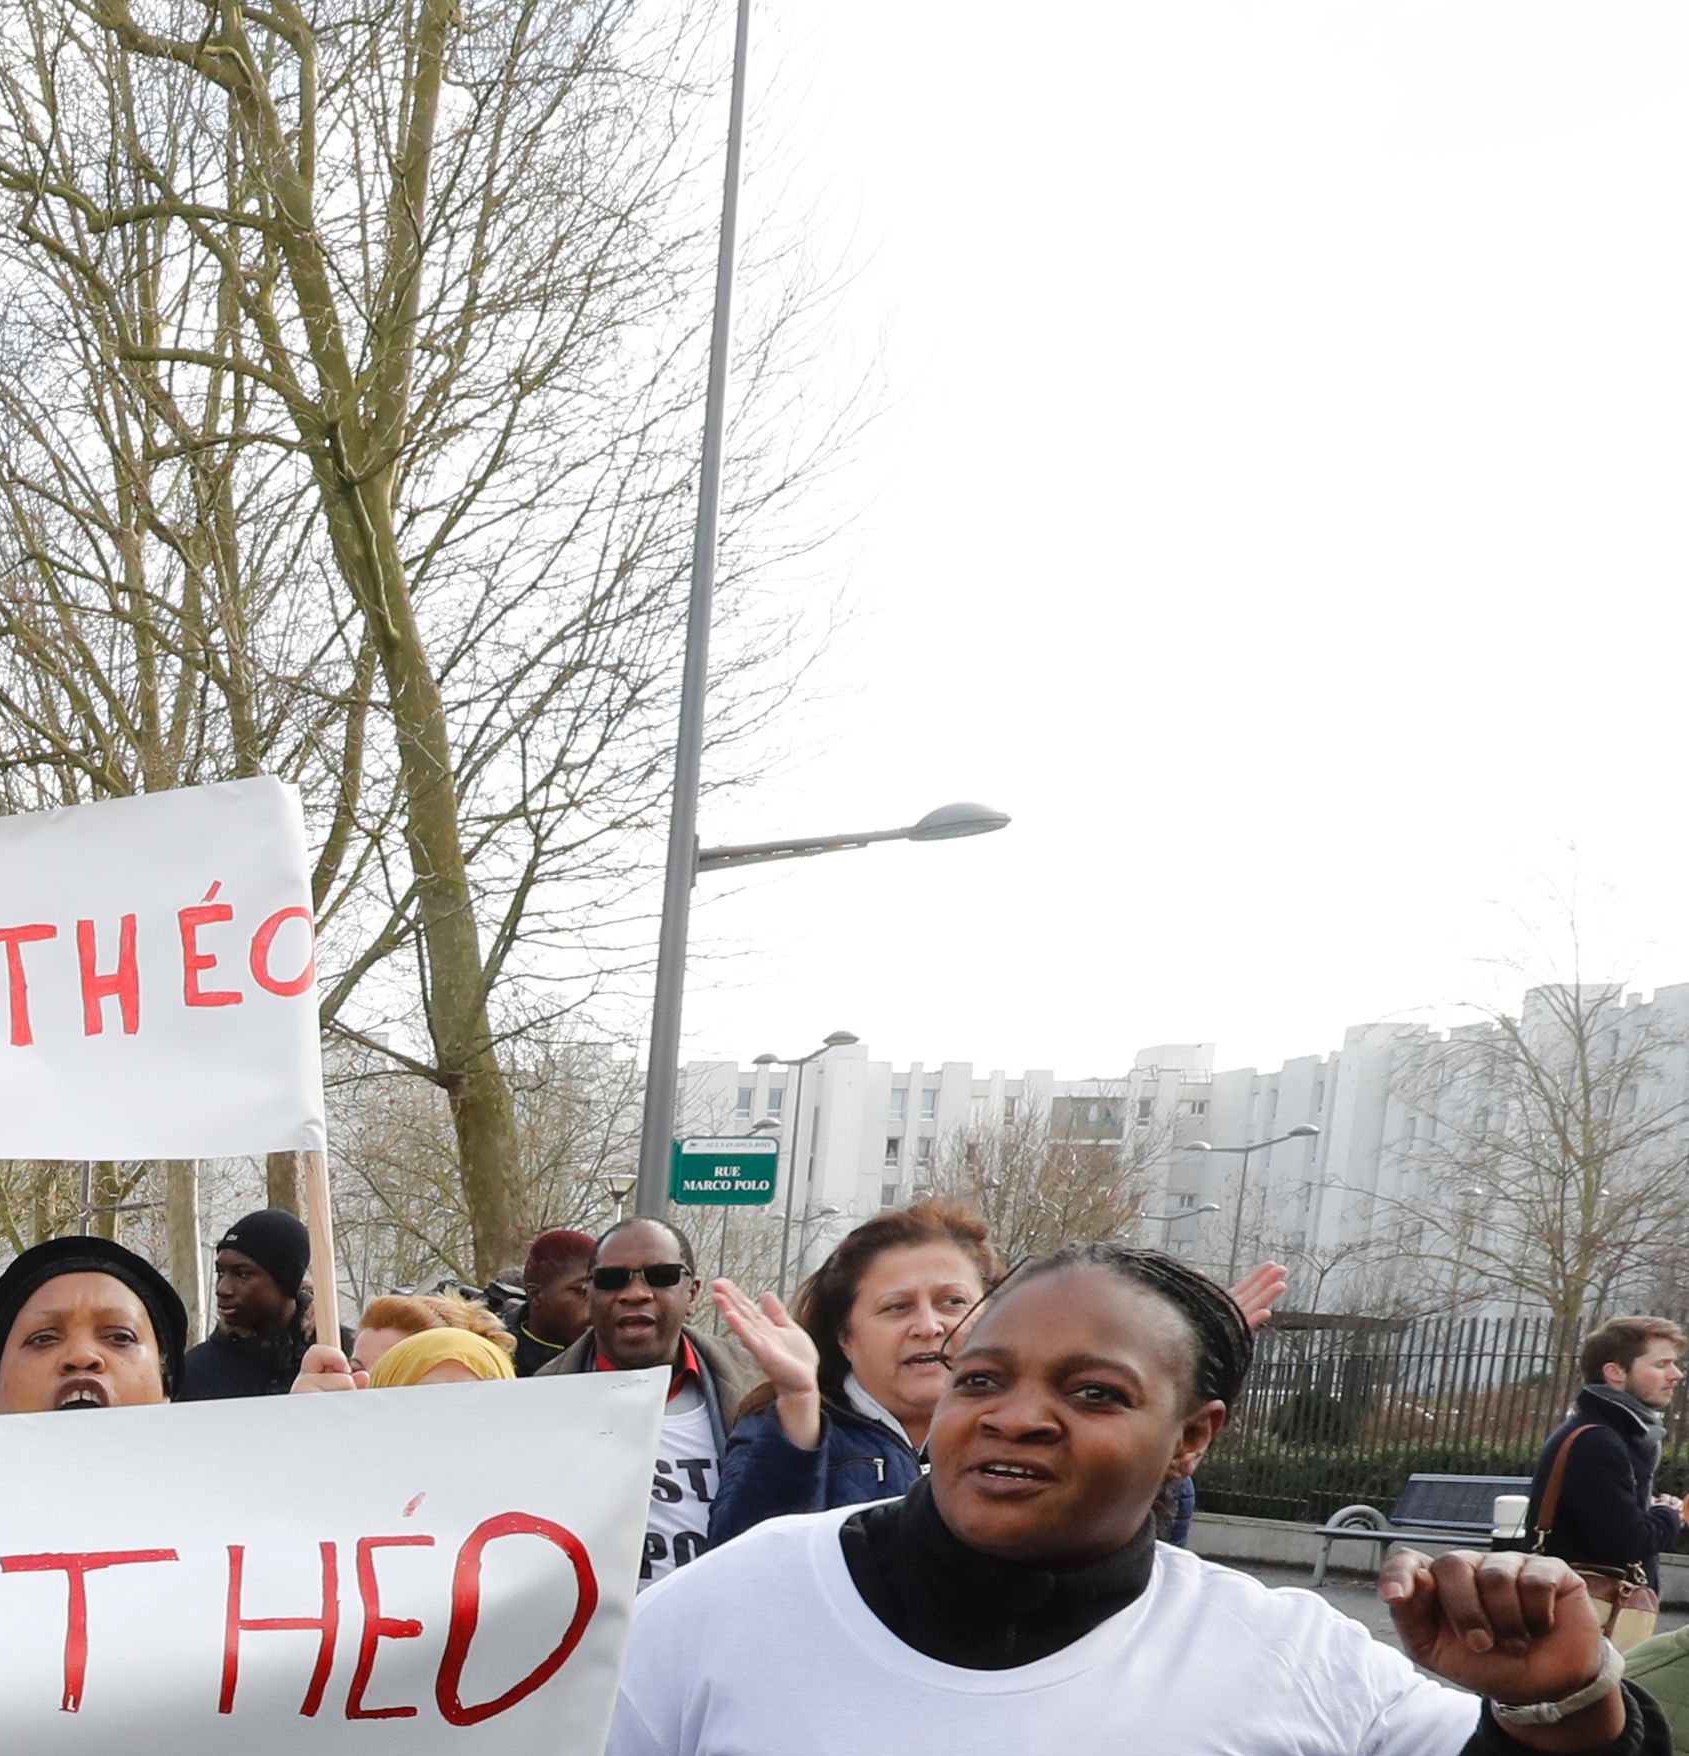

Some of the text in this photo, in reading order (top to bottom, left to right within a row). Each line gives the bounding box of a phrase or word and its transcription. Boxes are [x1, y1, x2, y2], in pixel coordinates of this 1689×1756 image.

[714, 1165, 741, 1177] RUE
[682, 1180, 771, 1191] MARCO POLO
[0, 1491, 599, 1727] THÉO
